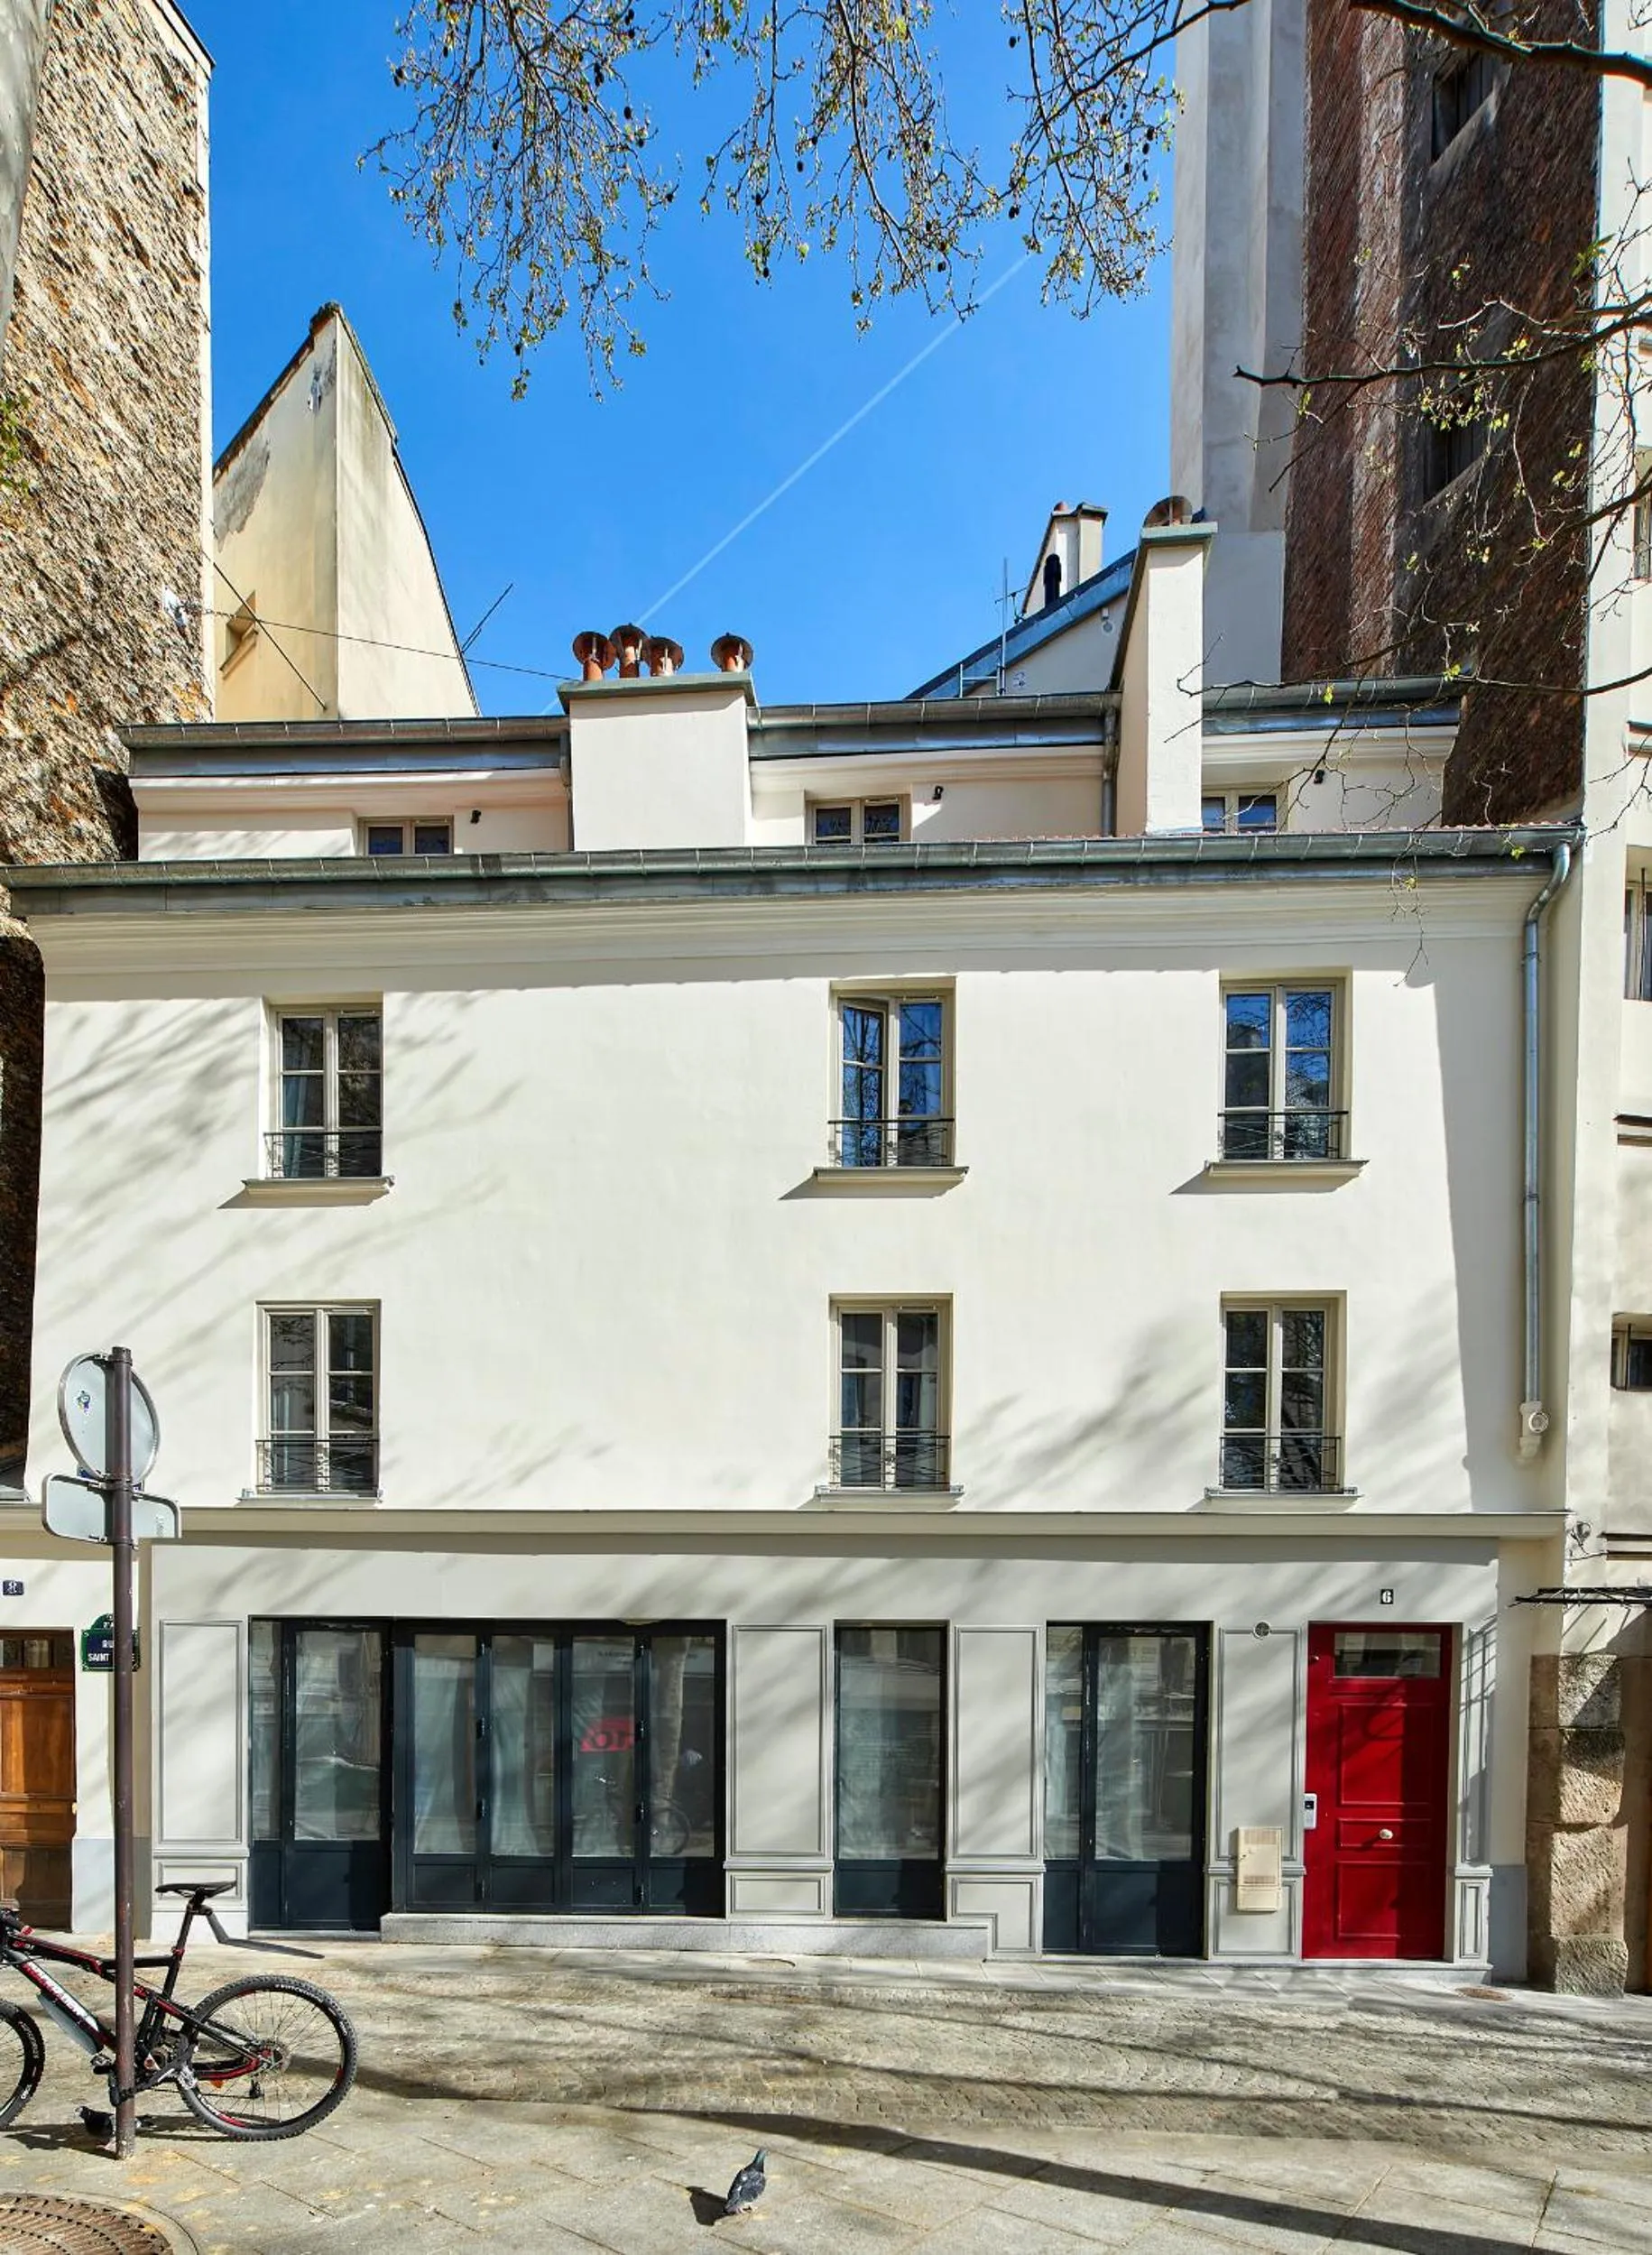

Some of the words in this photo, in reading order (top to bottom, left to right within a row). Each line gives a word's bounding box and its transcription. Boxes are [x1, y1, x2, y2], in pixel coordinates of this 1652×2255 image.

[1382, 1590, 1392, 1603] 6
[102, 1640, 114, 1649] RU
[88, 1653, 109, 1662] SAINT
